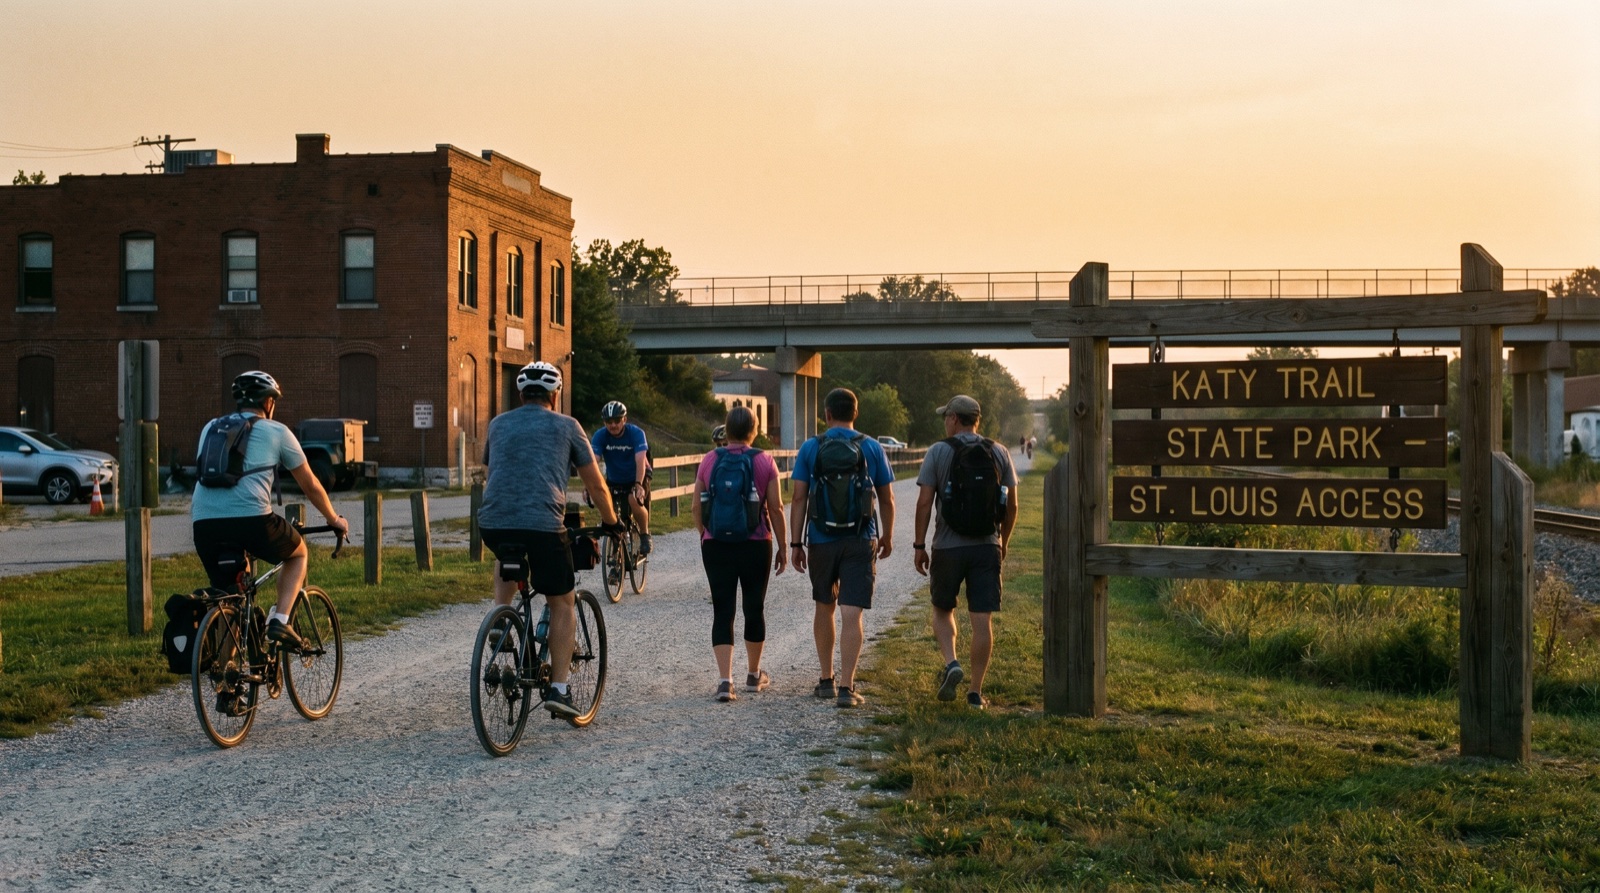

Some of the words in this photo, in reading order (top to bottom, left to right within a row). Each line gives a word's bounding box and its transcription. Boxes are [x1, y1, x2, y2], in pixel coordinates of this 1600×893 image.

[1172, 369, 1257, 400] KATY
[1276, 366, 1375, 398] TRAIL
[1167, 427, 1273, 459] STATE
[1294, 427, 1381, 459] PARK
[1130, 485, 1175, 514] ST.
[1191, 486, 1277, 517] LOUIS
[1296, 488, 1424, 519] ACCESS
